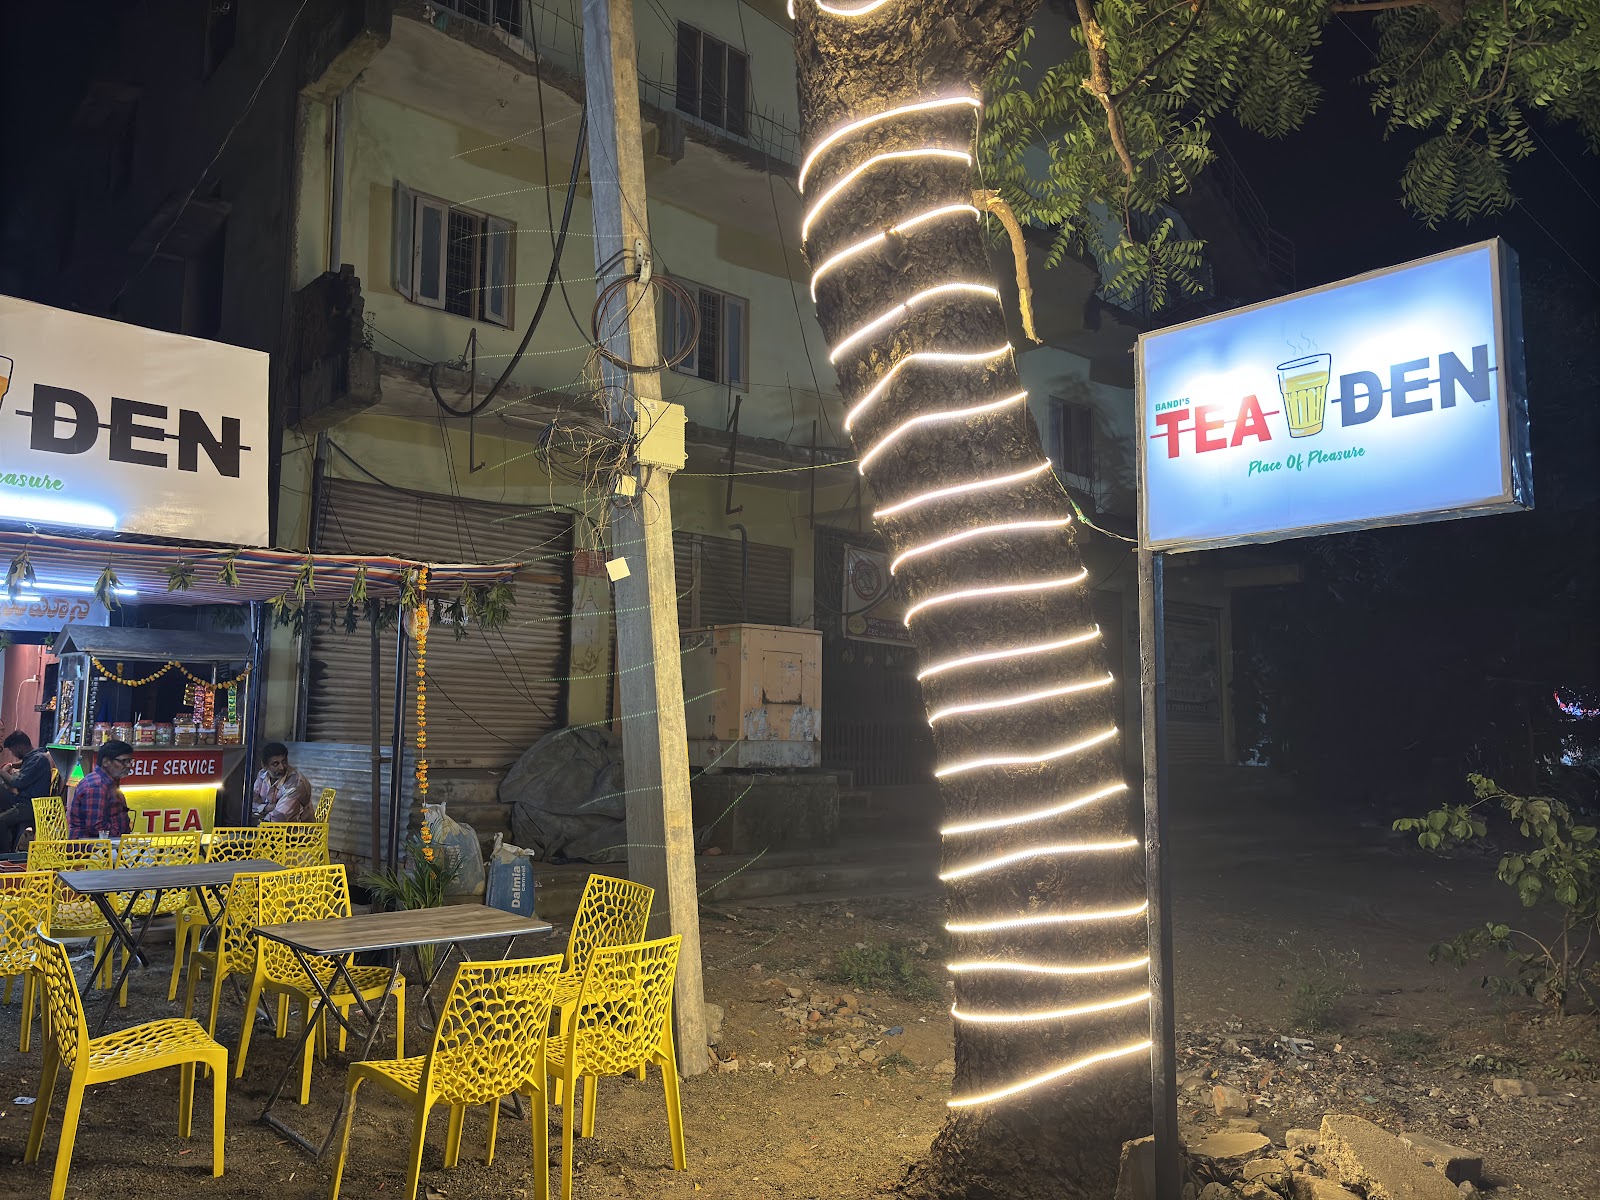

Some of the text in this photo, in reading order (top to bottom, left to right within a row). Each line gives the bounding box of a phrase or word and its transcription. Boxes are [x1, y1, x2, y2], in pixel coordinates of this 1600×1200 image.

[1155, 344, 1491, 459] TEA DEN
[1155, 397, 1190, 412] BANDI'S
[30, 383, 241, 478] DEN
[1248, 446, 1366, 477] Place Of Pleasure
[127, 759, 215, 776] SELF SERVICE
[142, 808, 203, 833] TEA
[511, 865, 521, 908] Dalmia
